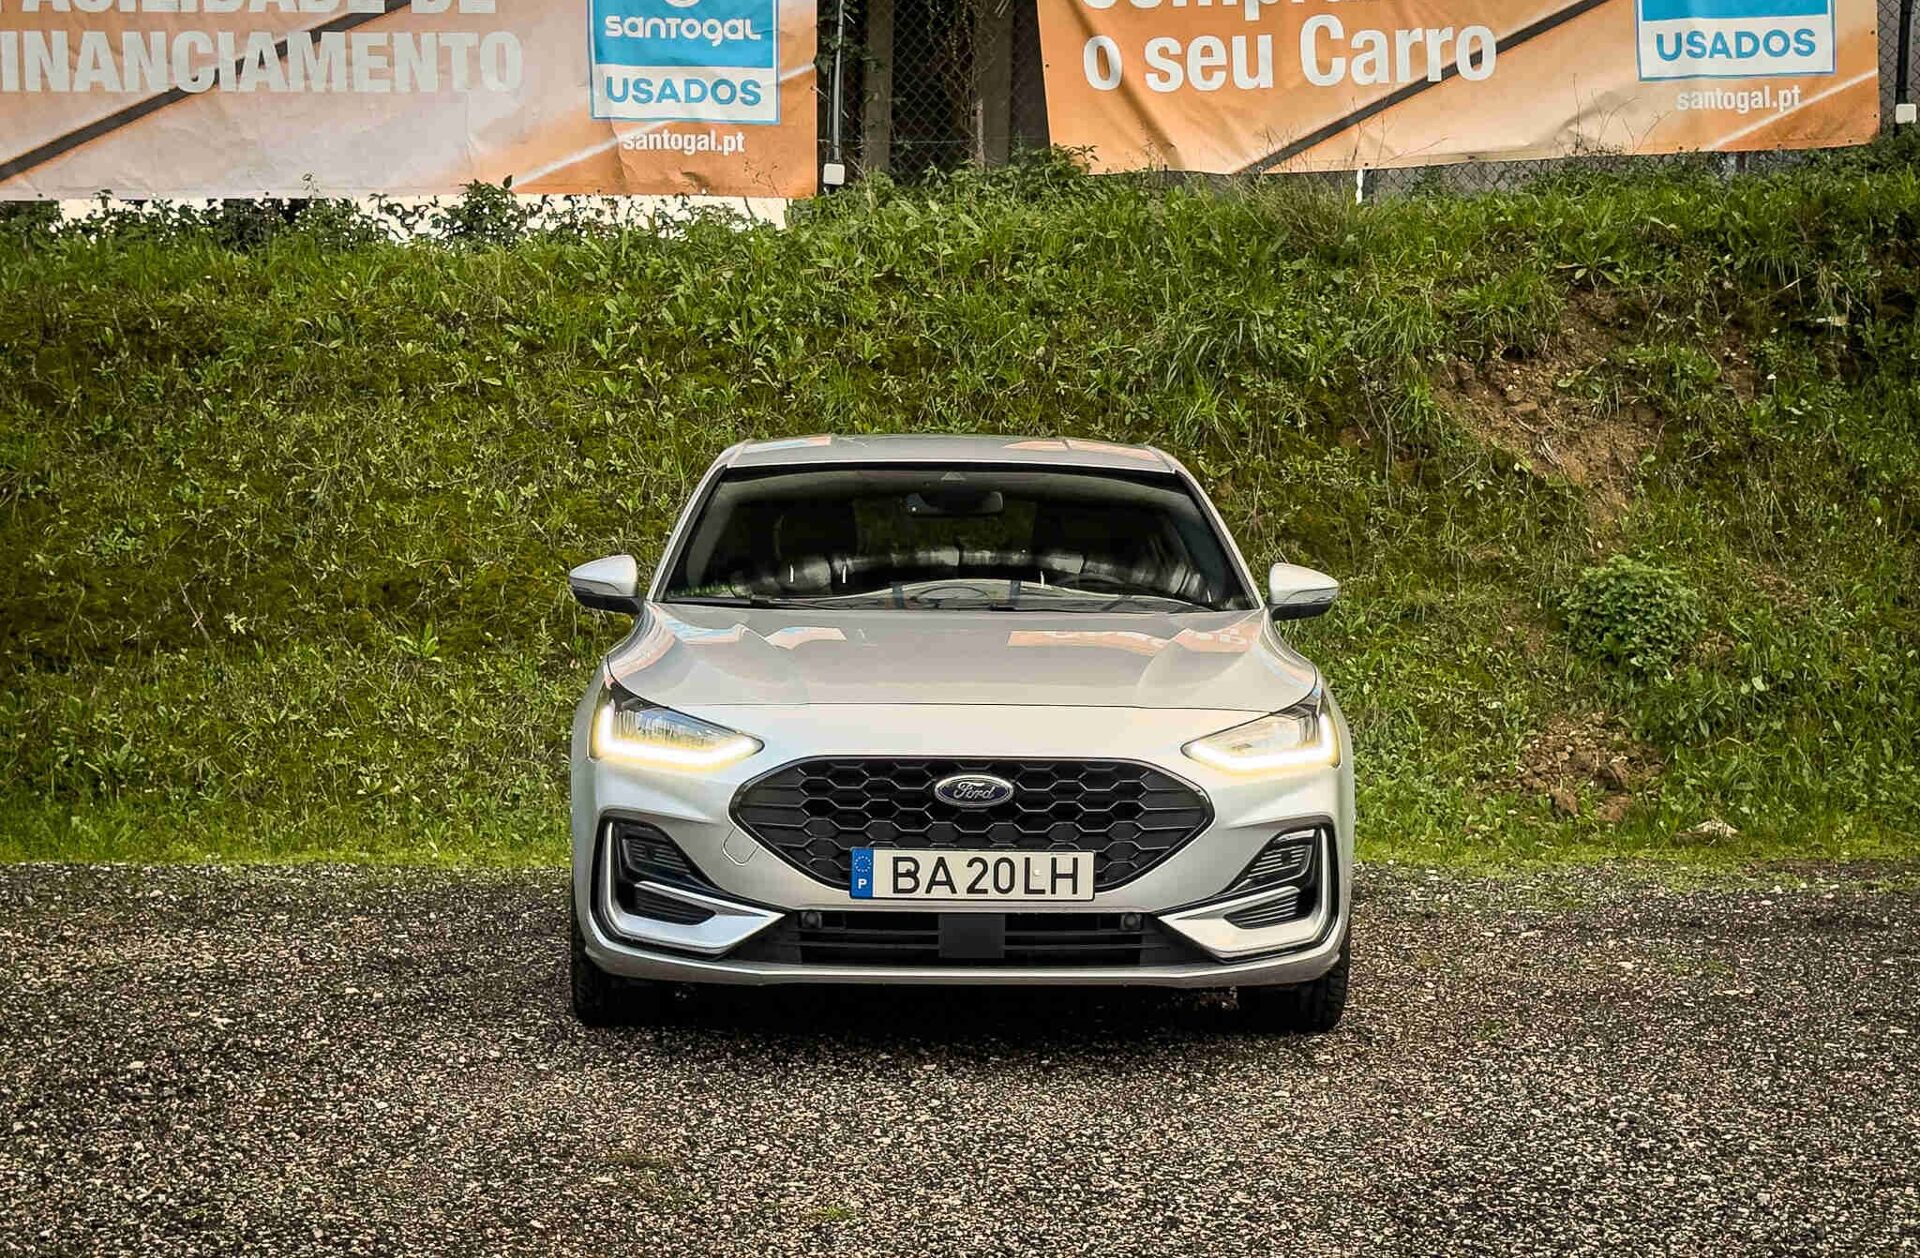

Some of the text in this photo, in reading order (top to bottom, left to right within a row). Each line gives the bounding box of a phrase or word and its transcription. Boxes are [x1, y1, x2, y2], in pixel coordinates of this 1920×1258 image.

[1082, 14, 1497, 92] o seu Carro
[1656, 28, 1816, 62] USADOS
[606, 77, 762, 106] USADOS
[1675, 85, 1801, 115] santogal.pt
[622, 129, 746, 156] santogal.pt
[953, 781, 995, 799] Ford
[857, 878, 868, 890] P
